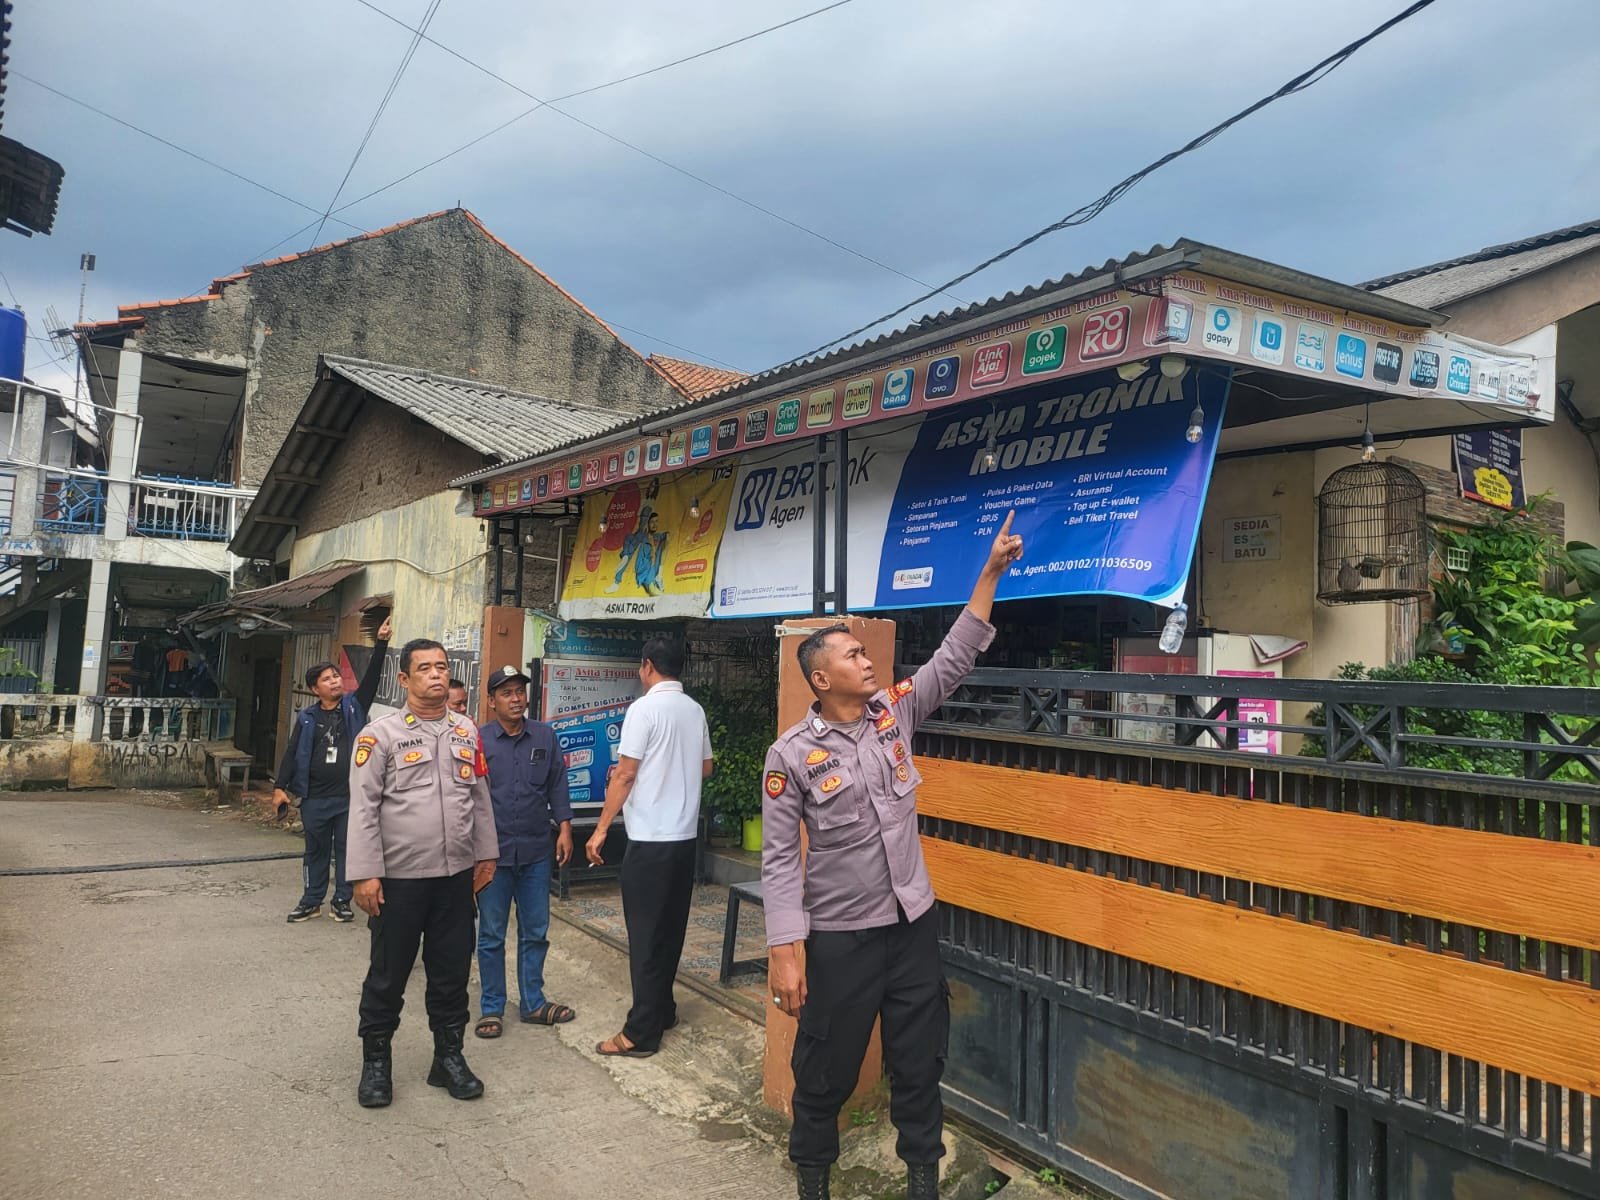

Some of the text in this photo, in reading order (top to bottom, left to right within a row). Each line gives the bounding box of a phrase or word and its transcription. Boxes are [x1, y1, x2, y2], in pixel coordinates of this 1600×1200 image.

[1206, 331, 1233, 348] gopay
[978, 347, 1003, 362] Link
[1028, 351, 1057, 367] gojek
[976, 360, 1000, 375] Aja!
[1449, 357, 1471, 378] Grab
[777, 403, 800, 420] Grab
[809, 399, 833, 416] maxim
[935, 366, 1191, 451] ASNA TRONIK
[968, 422, 1113, 477] MOBILE
[1078, 466, 1168, 484] BRI Virtual Account
[986, 480, 1053, 498] Pulsa & Paket Data
[1074, 484, 1113, 498] Asuransi
[983, 495, 1037, 510] Voucher Game
[1072, 495, 1140, 512] Top up E-wallet
[769, 504, 806, 529] Agen
[907, 511, 938, 522] Simpanan
[980, 513, 999, 524] BPJS
[1085, 512, 1106, 524] Tiket
[1109, 510, 1139, 521] Travel
[977, 526, 993, 537] PLN
[1233, 519, 1270, 531] SEDIA
[1233, 534, 1249, 545] ES
[1234, 547, 1266, 559] BATU
[1009, 556, 1153, 578] No. Agen: 002/0102/11036509
[576, 626, 637, 641] BANK
[558, 702, 591, 713] DOMPET
[397, 738, 423, 750] IWAN
[451, 736, 475, 746] POLRI
[806, 757, 841, 781] AHMAD
